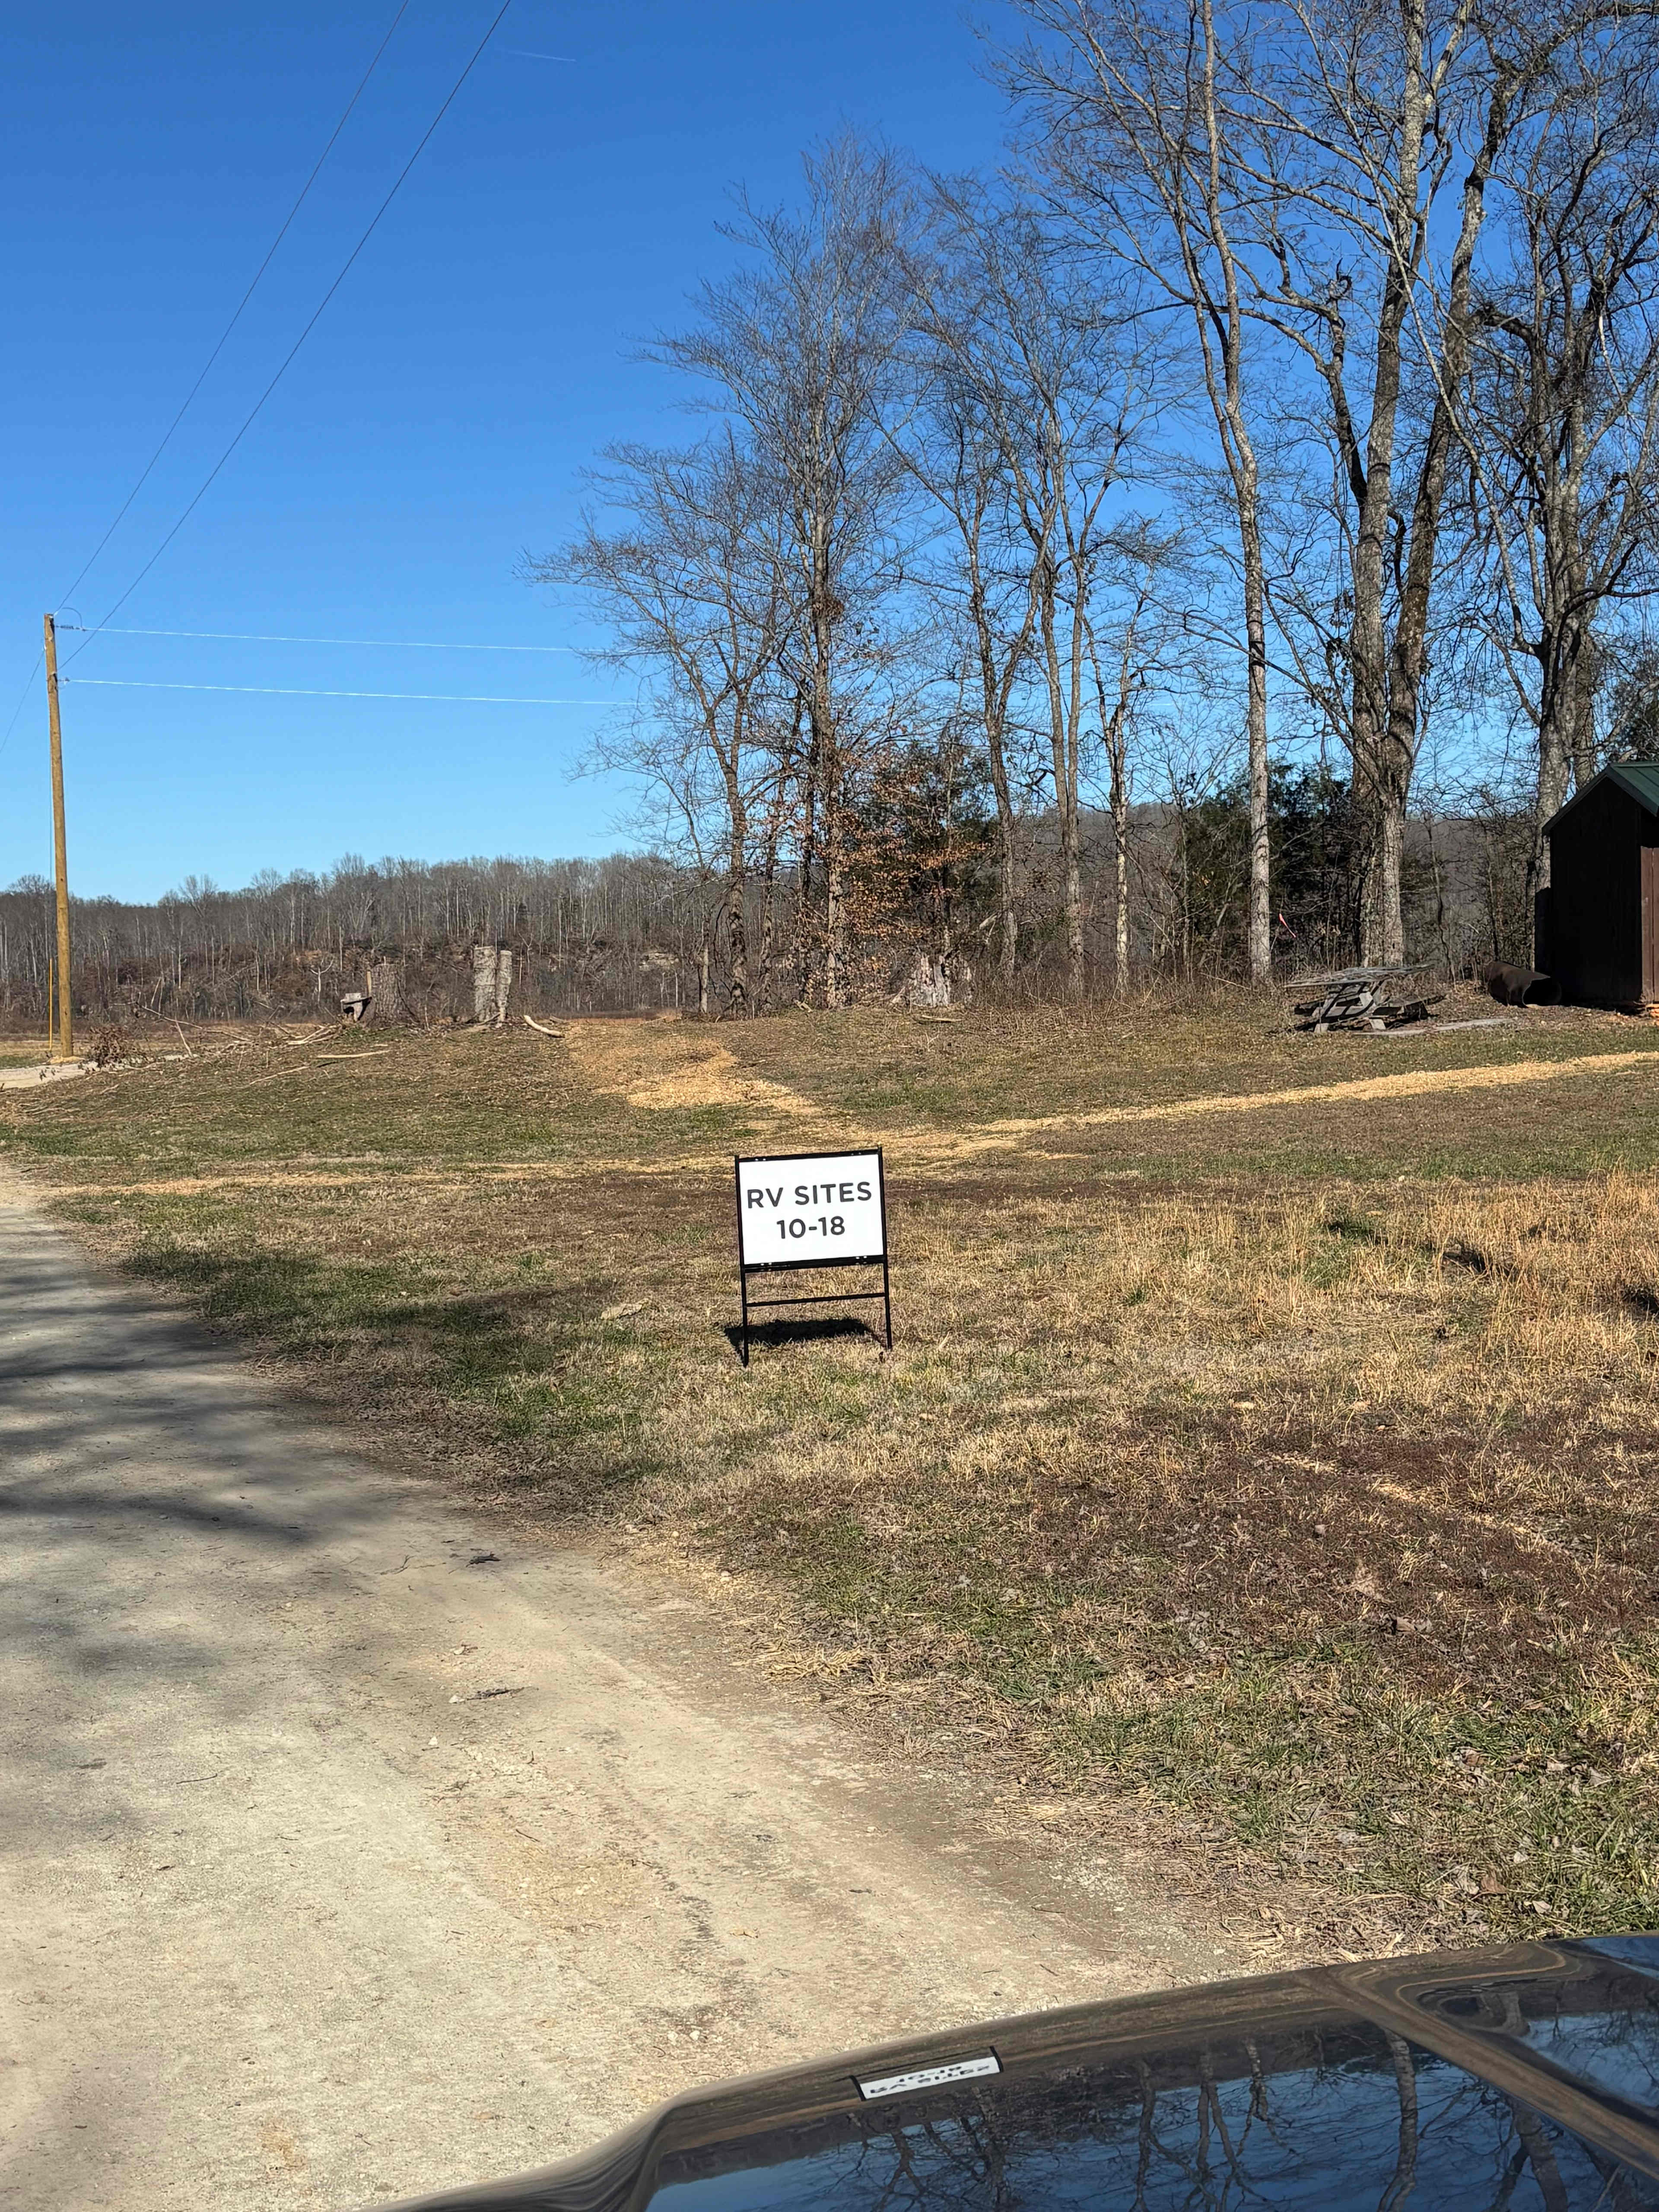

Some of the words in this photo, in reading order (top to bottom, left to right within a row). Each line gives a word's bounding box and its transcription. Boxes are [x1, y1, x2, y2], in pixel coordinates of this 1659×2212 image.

[747, 1187, 784, 1209] RV
[795, 1182, 872, 1205] SITES
[776, 1216, 845, 1239] 10-18
